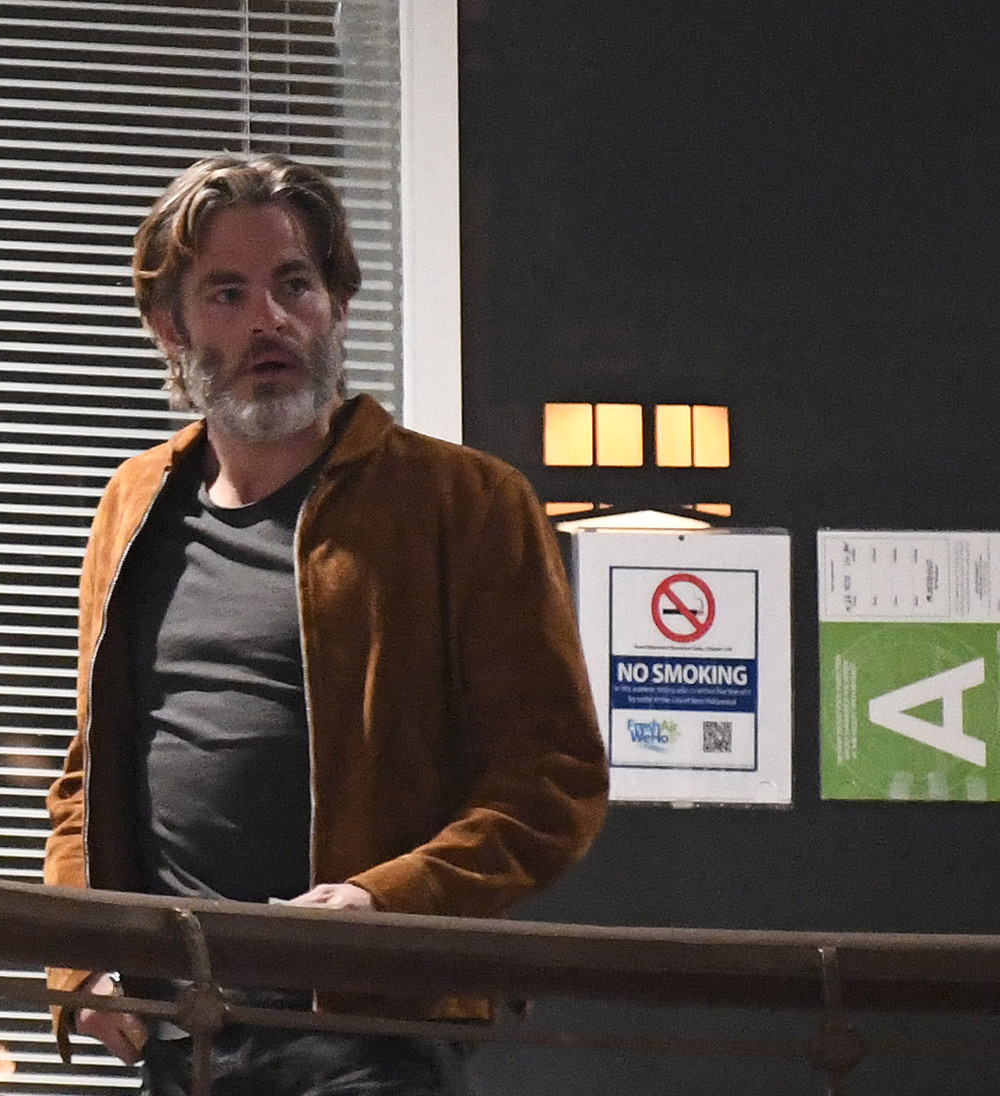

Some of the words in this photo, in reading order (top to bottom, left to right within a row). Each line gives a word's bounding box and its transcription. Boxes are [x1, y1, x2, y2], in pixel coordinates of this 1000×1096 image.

[617, 662, 649, 683] NO
[651, 663, 748, 686] SMOKING
[868, 657, 987, 767] A
